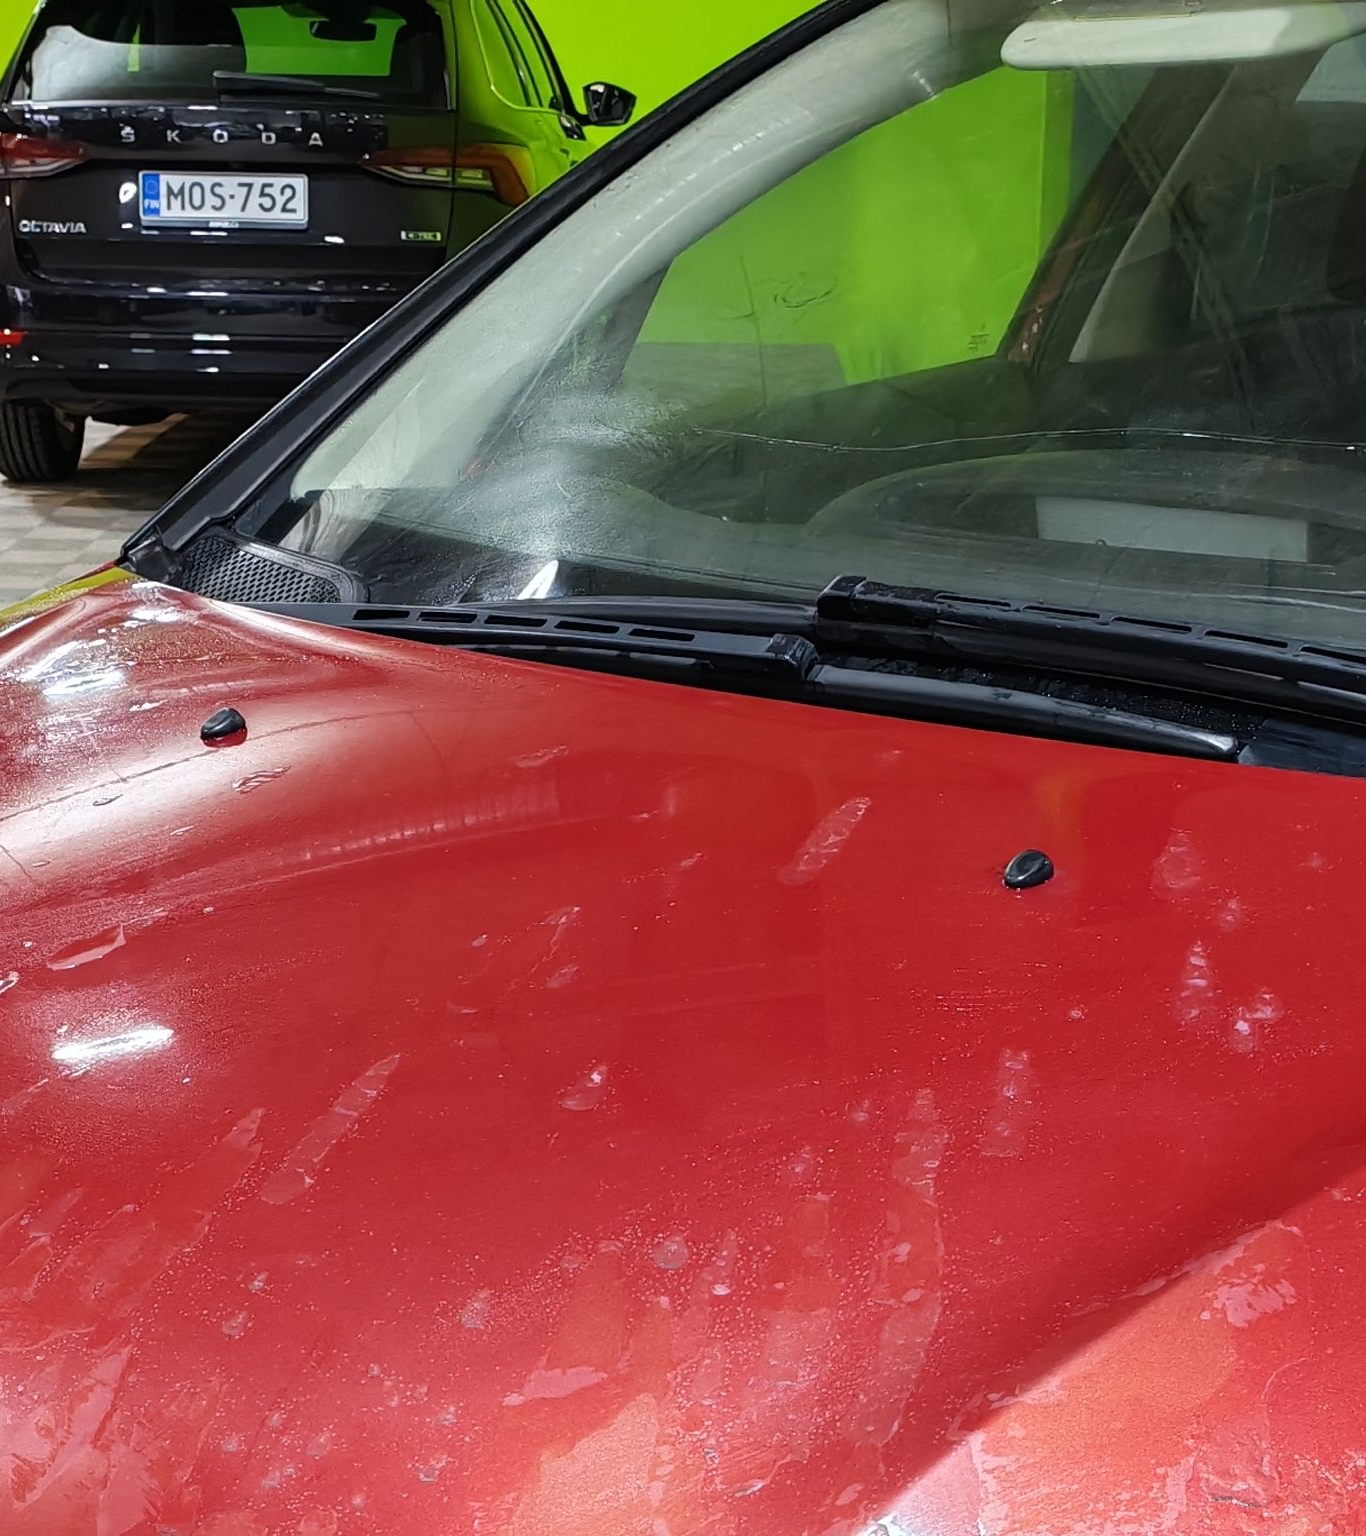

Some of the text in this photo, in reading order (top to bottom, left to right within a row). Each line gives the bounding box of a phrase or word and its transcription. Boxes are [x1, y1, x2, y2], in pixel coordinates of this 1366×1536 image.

[144, 199, 160, 210] FIN
[165, 181, 298, 214] MOS-752
[18, 219, 87, 233] OCTAVIA
